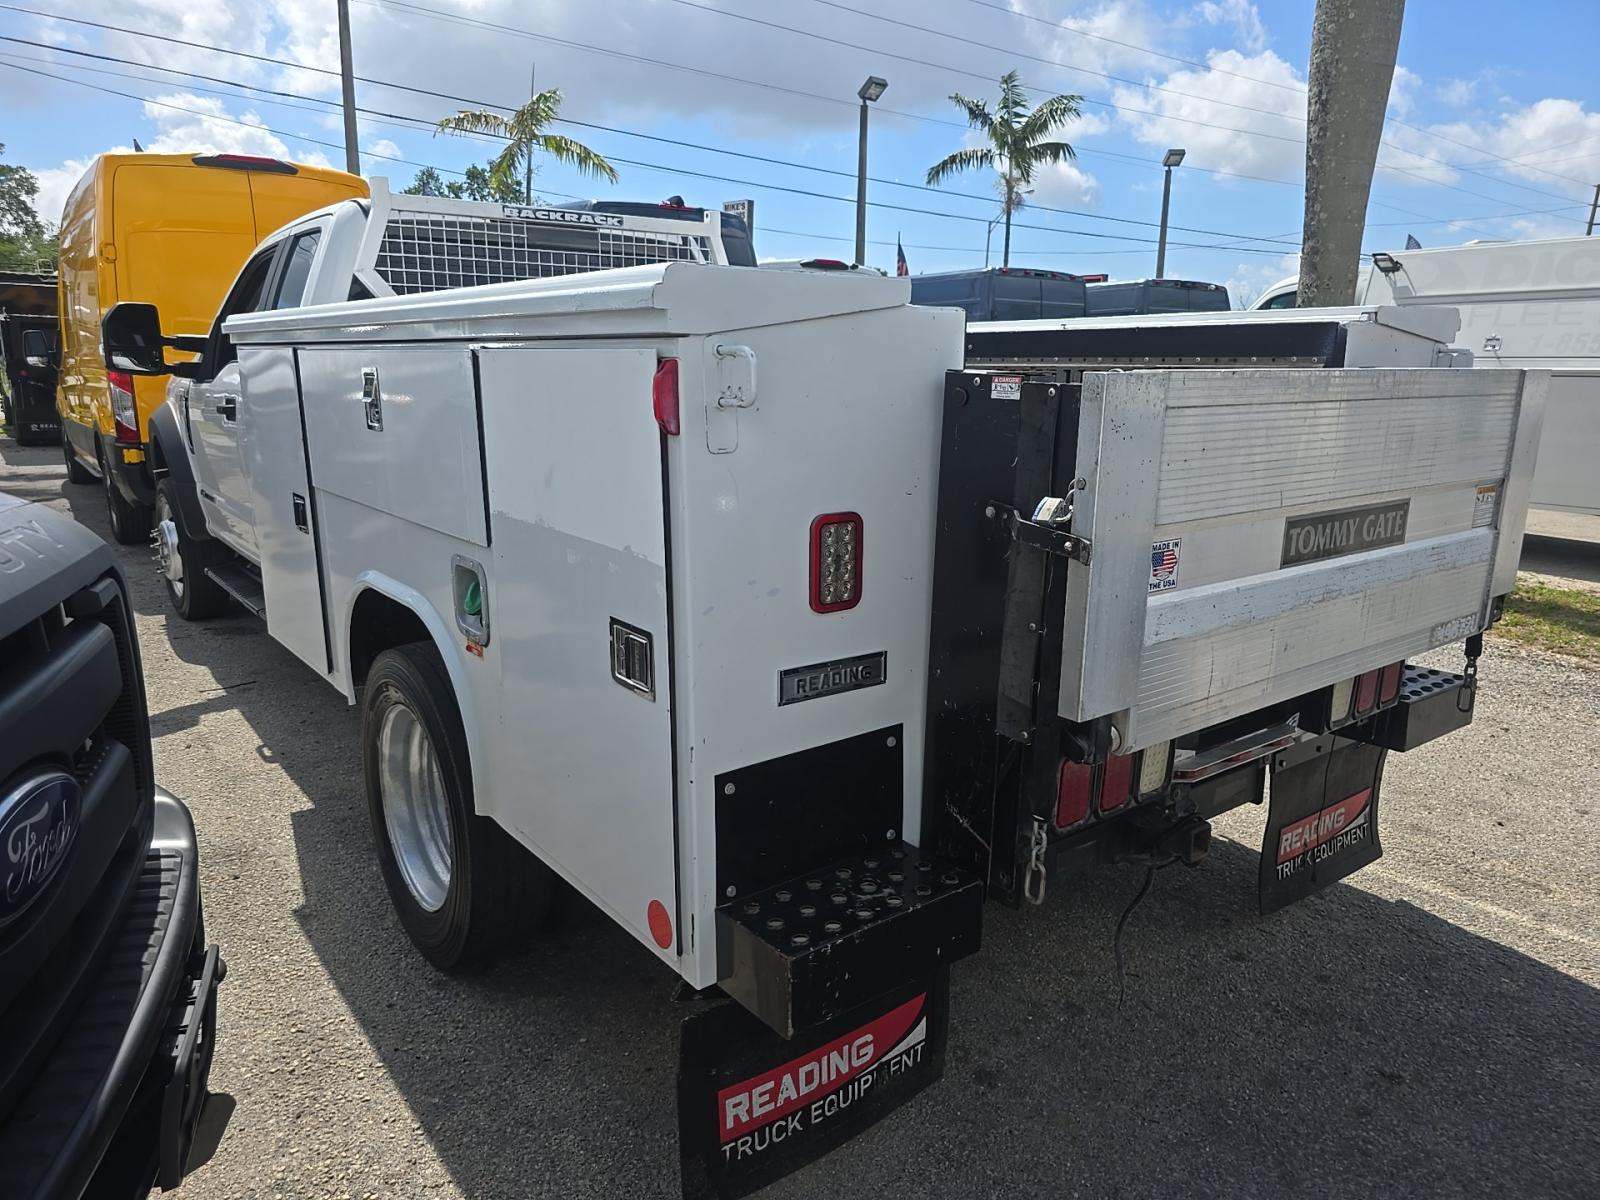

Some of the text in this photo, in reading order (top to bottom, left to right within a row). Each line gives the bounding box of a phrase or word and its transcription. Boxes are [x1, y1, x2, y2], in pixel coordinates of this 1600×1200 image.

[503, 207, 621, 226] BACKRACK
[1152, 543, 1170, 551] MADE
[1289, 510, 1404, 556] TOMMY GATE
[1149, 580, 1175, 590] THE USA
[795, 666, 872, 695] READING
[6, 800, 71, 903] Ford
[1281, 807, 1345, 855] READING
[1314, 823, 1368, 863] EQUIPMENT
[725, 1034, 874, 1130] READING
[721, 1111, 803, 1162] TRUCK
